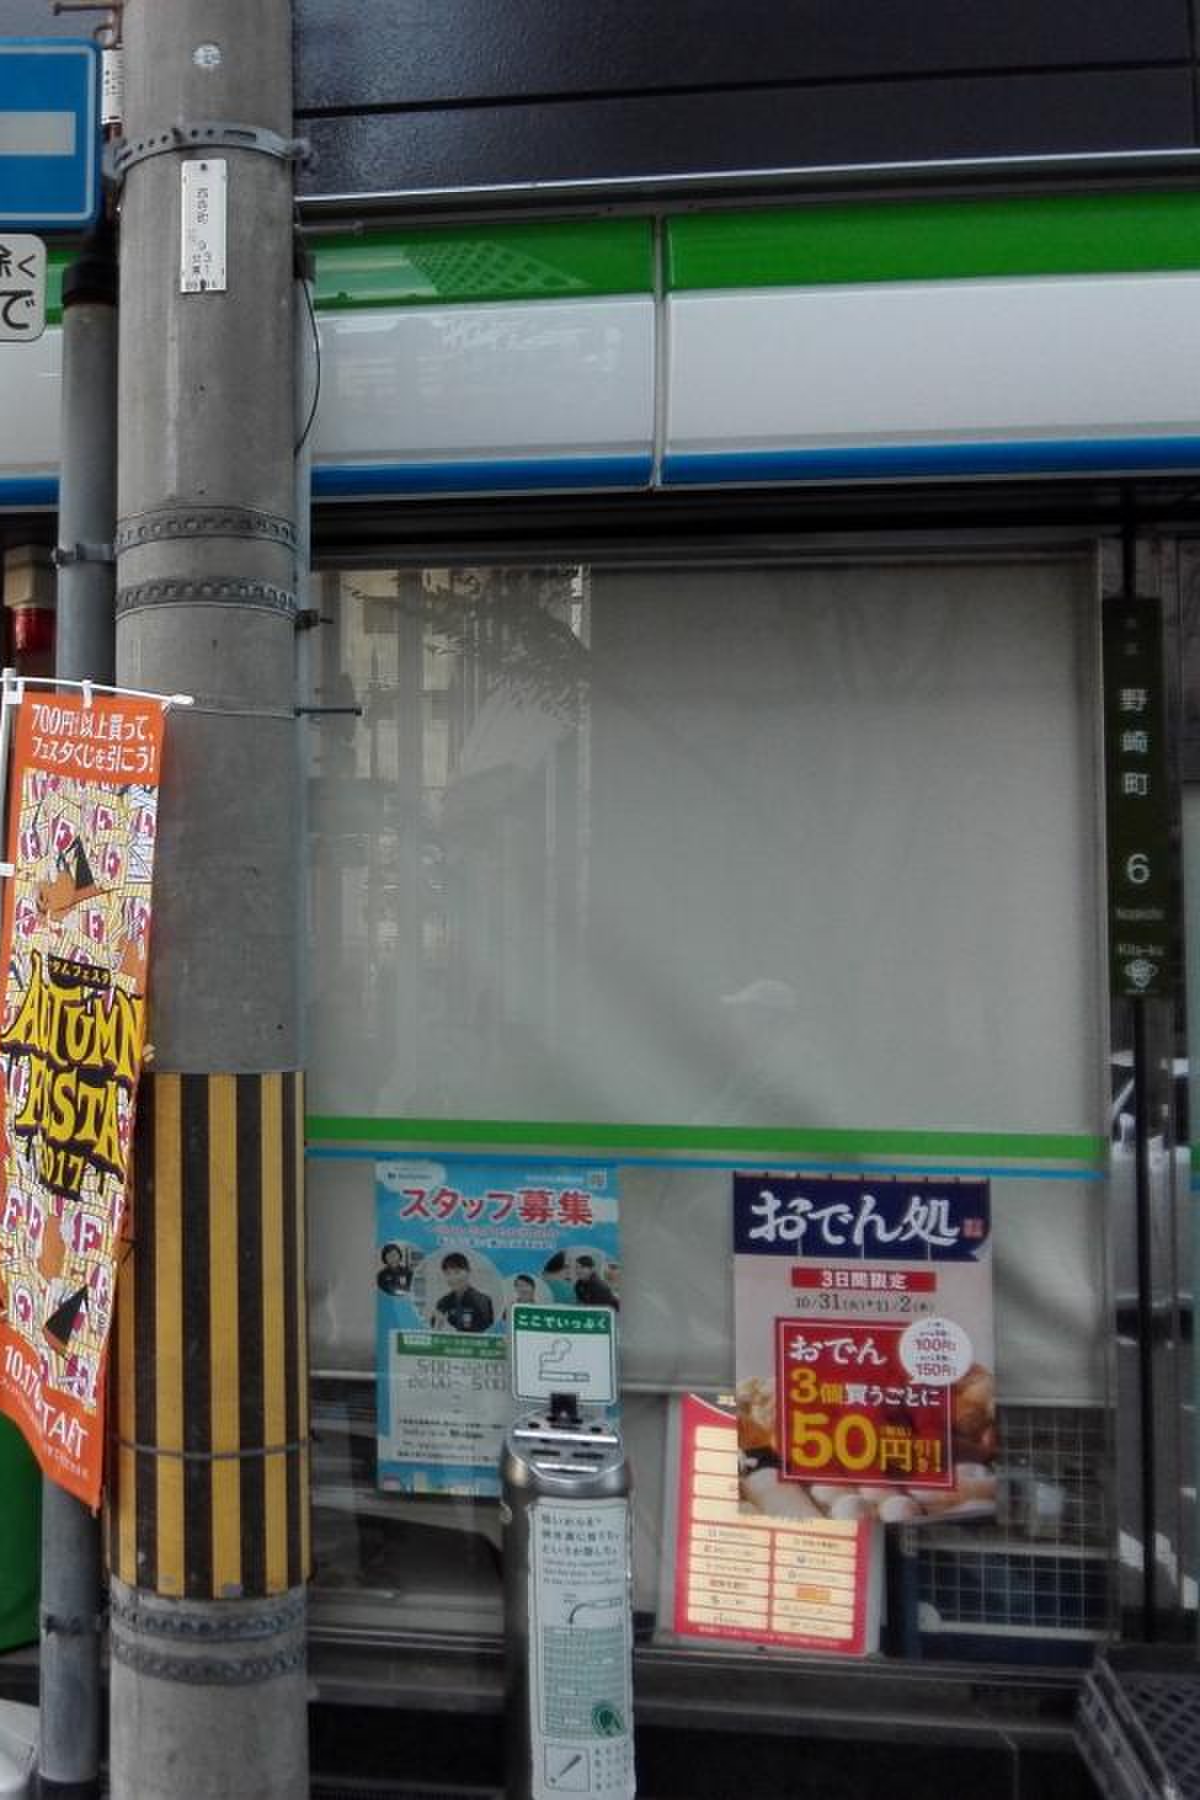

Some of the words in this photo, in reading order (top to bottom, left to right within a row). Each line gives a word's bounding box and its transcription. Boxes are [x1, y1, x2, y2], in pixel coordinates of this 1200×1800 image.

[1126, 853, 1151, 884] 6
[401, 1187, 593, 1226] スタッフ募集
[749, 1190, 961, 1246] おでん処
[821, 1270, 908, 1291] 3日間限定
[788, 1335, 888, 1366] おでん
